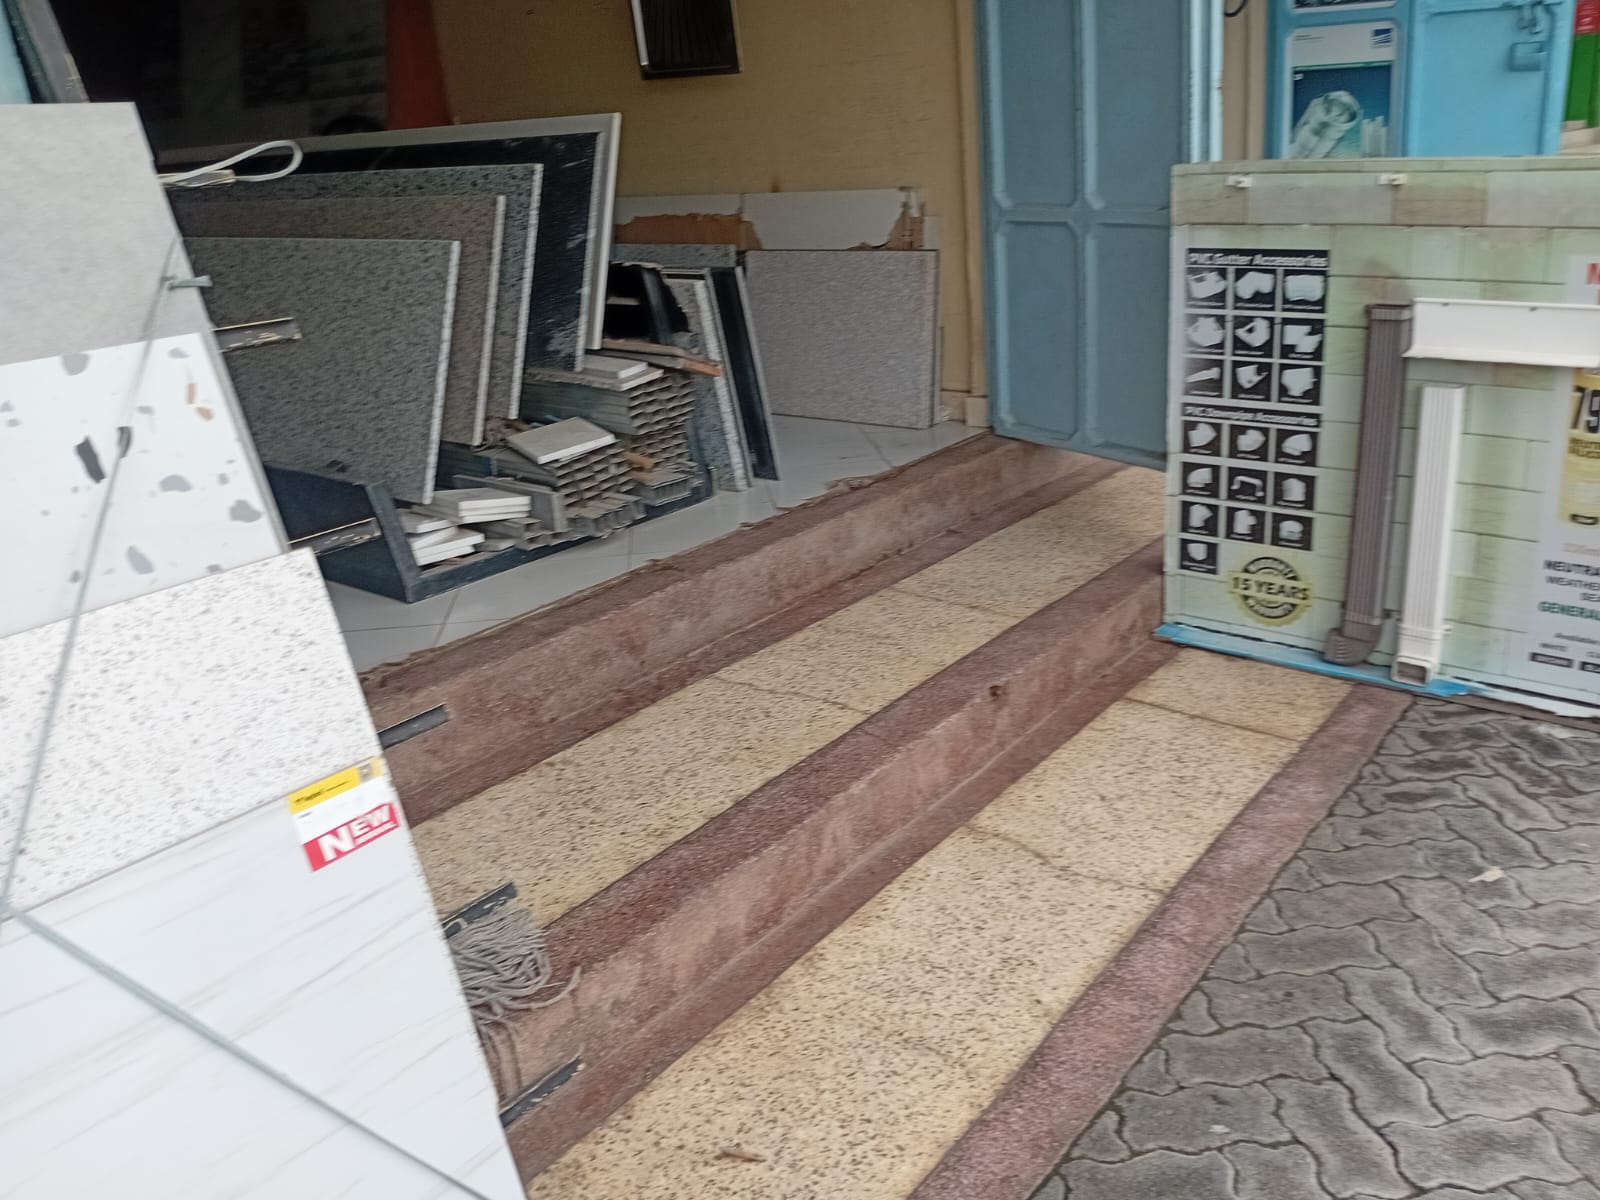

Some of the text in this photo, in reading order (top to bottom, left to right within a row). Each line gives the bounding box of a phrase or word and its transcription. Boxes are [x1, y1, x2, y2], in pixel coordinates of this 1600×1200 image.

[1231, 575, 1310, 601] 15 YEARS
[317, 803, 390, 862] NEW
